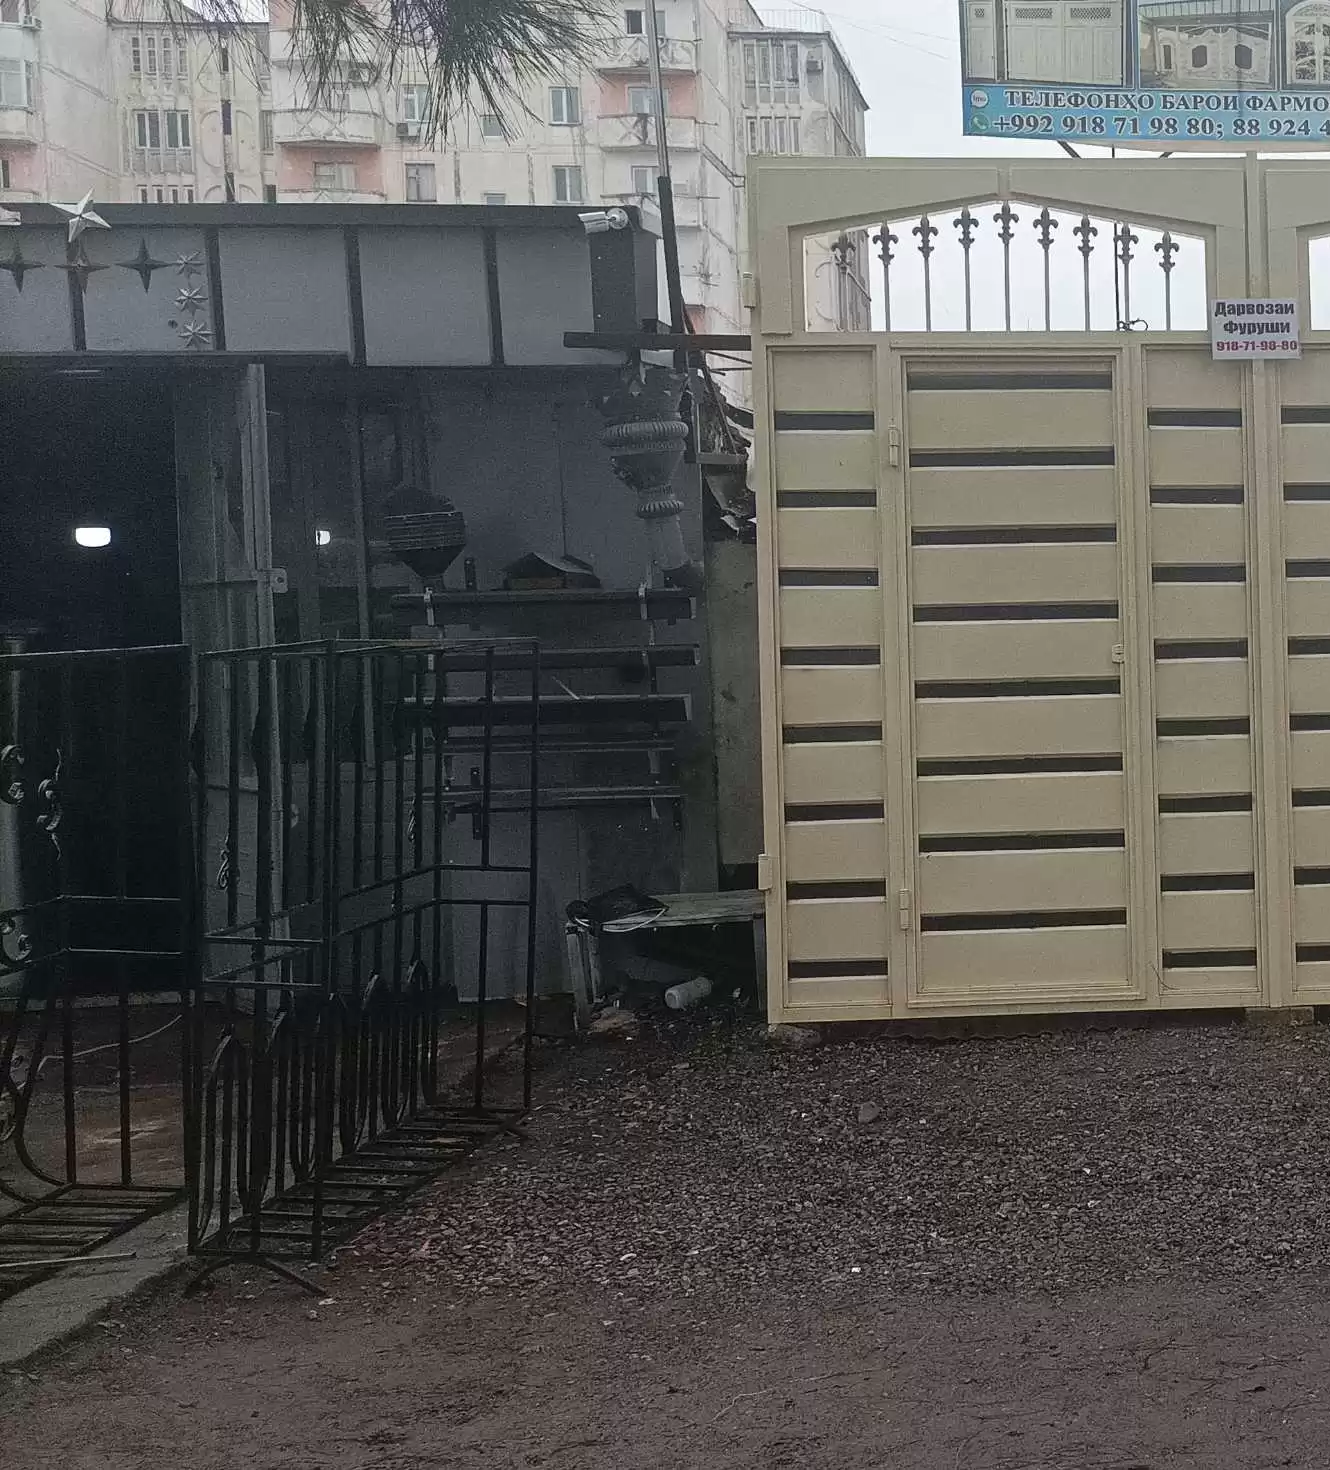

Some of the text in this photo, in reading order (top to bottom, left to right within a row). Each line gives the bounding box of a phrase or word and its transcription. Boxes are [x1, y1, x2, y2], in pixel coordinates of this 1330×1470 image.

[1005, 91, 1154, 112] ТЕЛЕФОНҲО
[1160, 94, 1238, 111] БАРОИ
[994, 114, 1053, 133] +992
[1062, 115, 1105, 134] 918
[1113, 117, 1141, 135] 71
[1150, 117, 1178, 135] 98
[1186, 118, 1223, 139] 80;
[1233, 118, 1261, 136] 88
[1268, 119, 1311, 136] 924
[1214, 302, 1295, 317] Дарвозаи
[1223, 320, 1291, 335] Фуруши
[1216, 340, 1298, 352] 918-71-98-80
